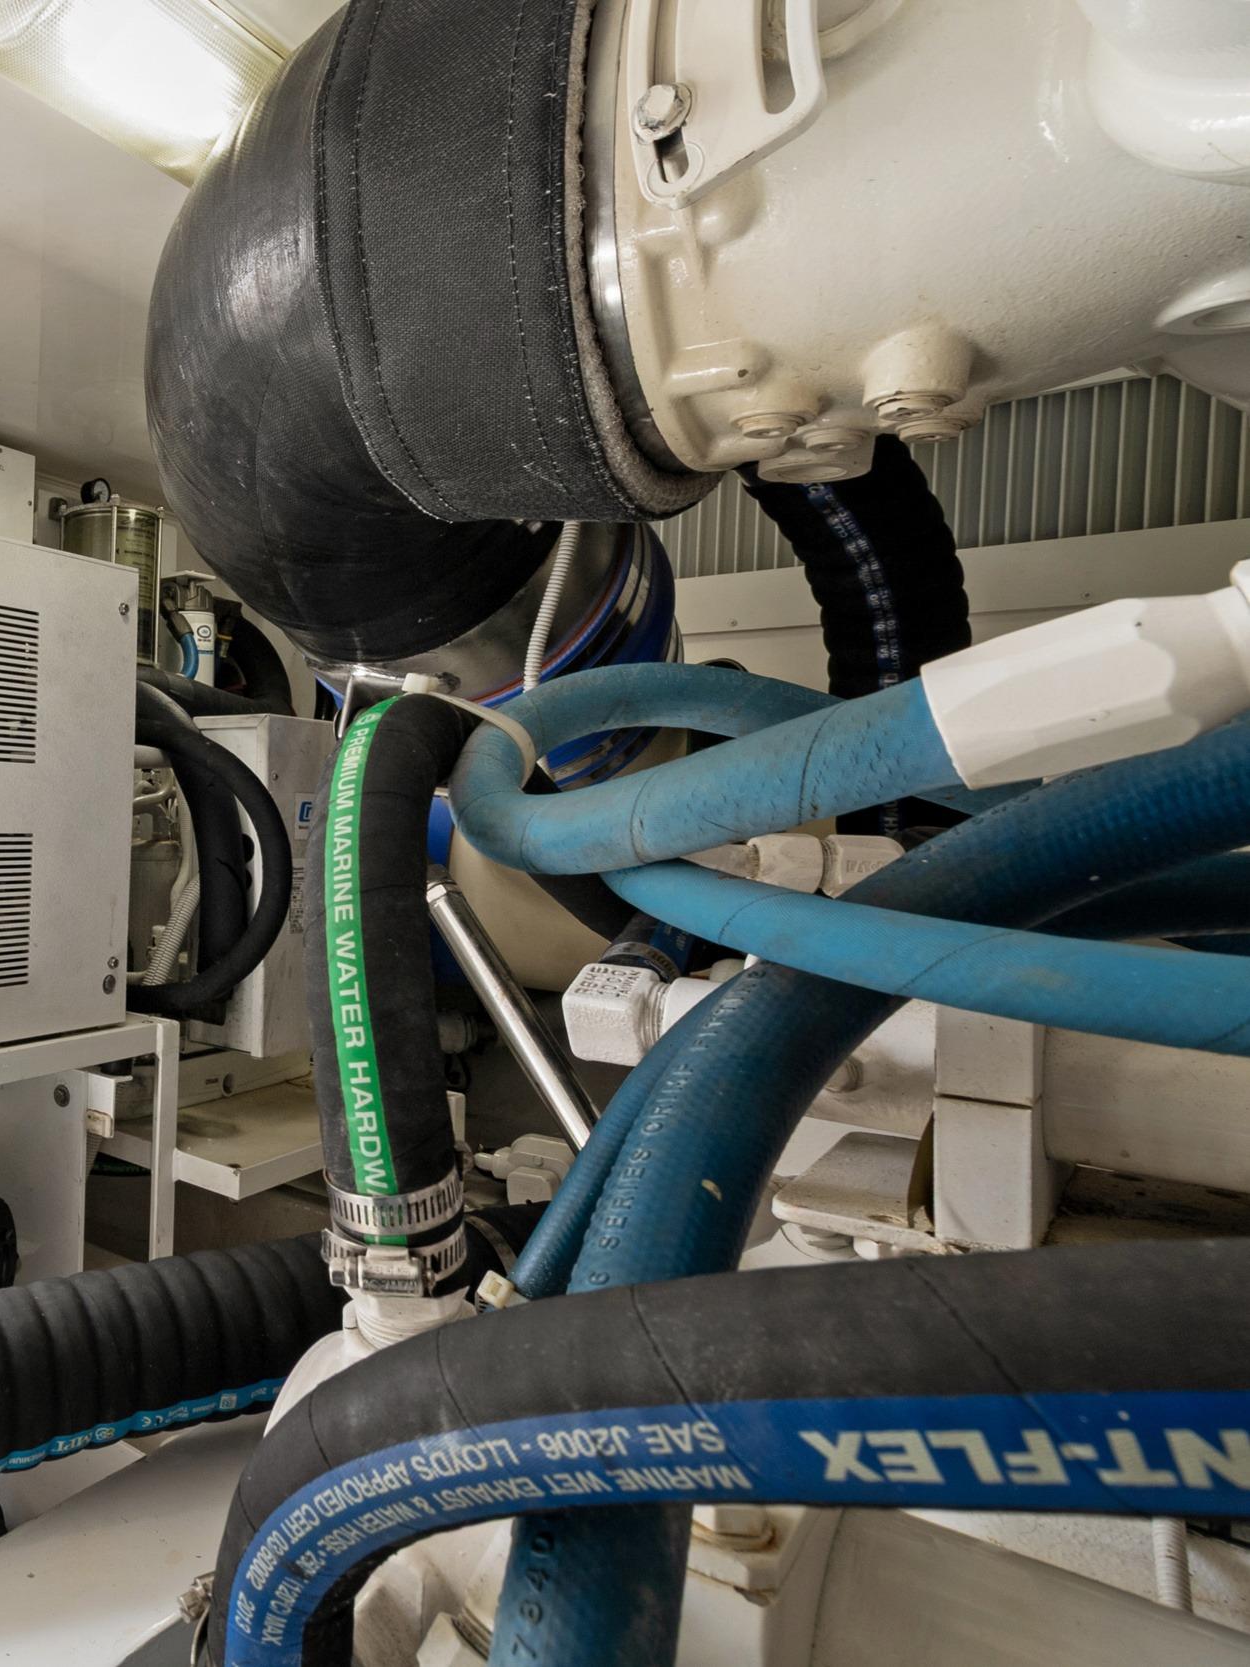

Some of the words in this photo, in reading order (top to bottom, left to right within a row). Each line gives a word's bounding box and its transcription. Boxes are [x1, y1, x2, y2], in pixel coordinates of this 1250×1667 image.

[336, 727, 371, 811] PREMIUM
[333, 815, 354, 923] MARINE
[335, 930, 366, 1049] WATER
[348, 1060, 388, 1195] HARDW
[599, 1148, 652, 1250] SERIES
[538, 1424, 631, 1462] J2006
[638, 1419, 726, 1454] SAE
[314, 1462, 413, 1518] APPROVED
[437, 1474, 546, 1512] EXHAUST
[543, 1470, 614, 1497] WET
[606, 1464, 754, 1492] MARINE
[363, 1501, 421, 1534] WATER
[413, 1496, 436, 1516] &
[288, 1507, 322, 1544] CERT
[326, 1520, 362, 1557] HOSE
[235, 1591, 256, 1634] 2013
